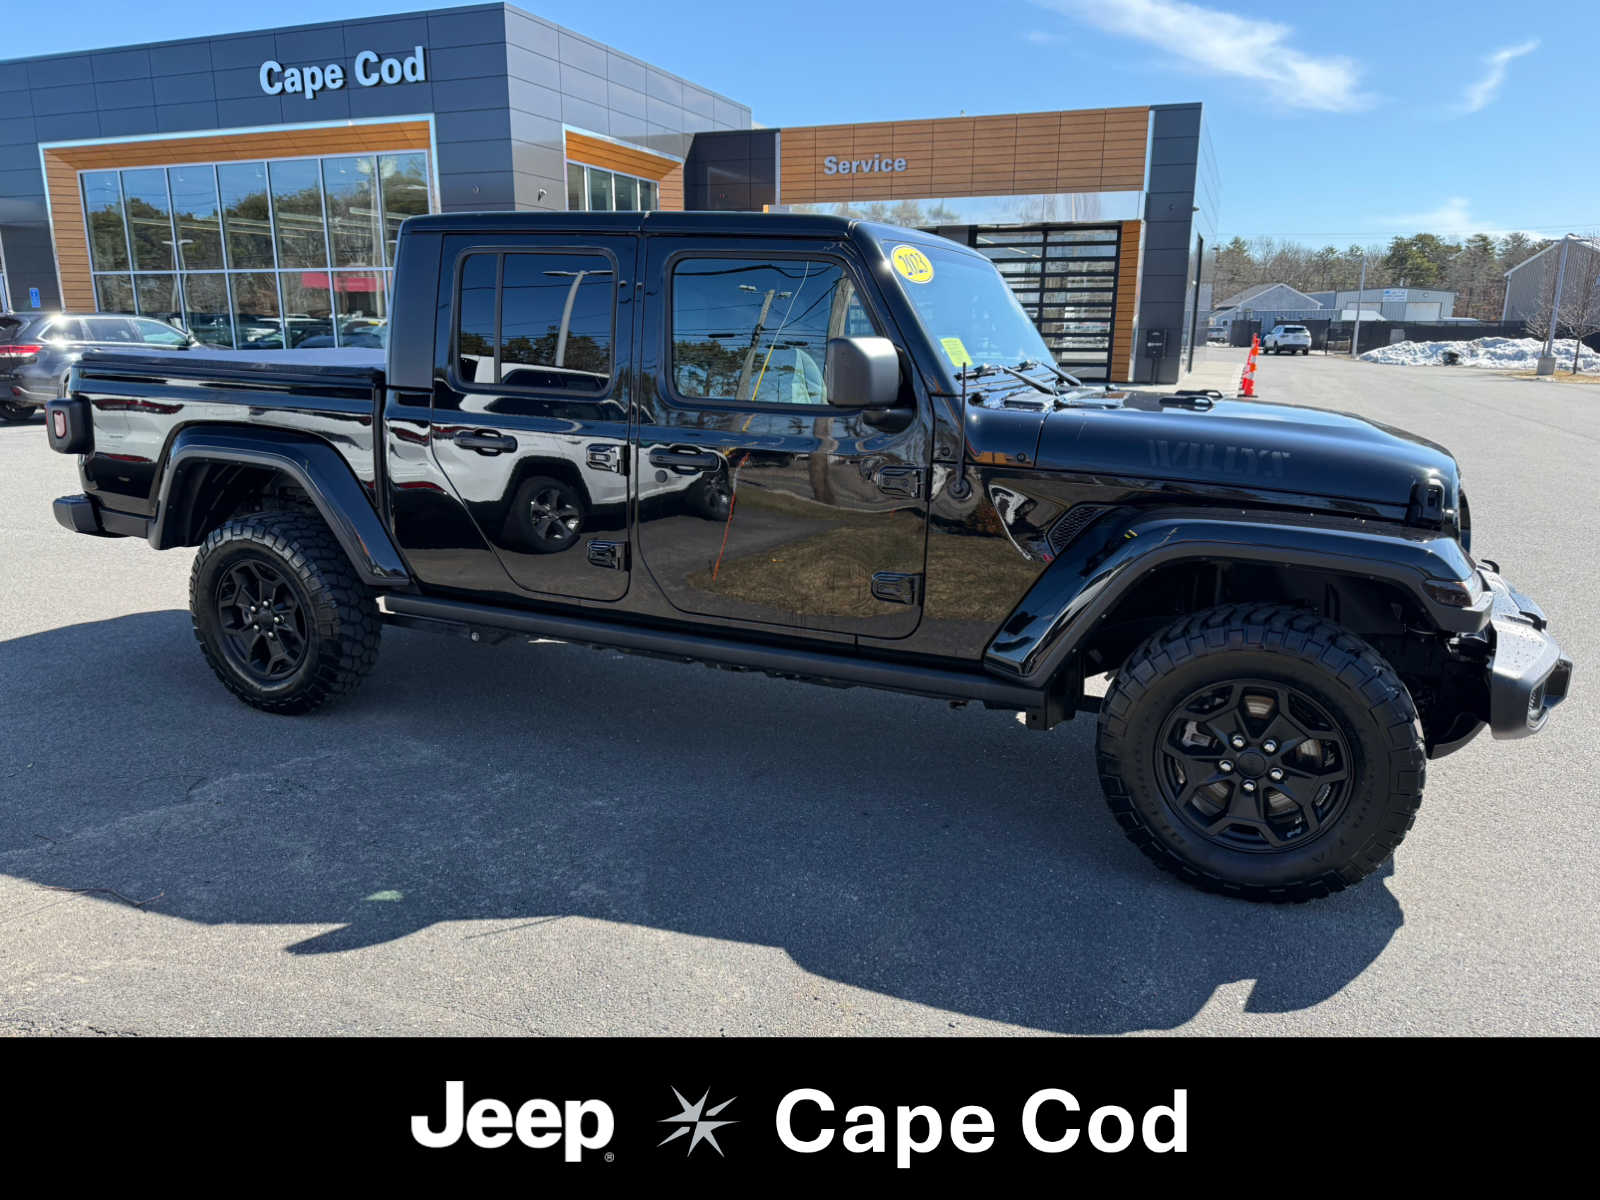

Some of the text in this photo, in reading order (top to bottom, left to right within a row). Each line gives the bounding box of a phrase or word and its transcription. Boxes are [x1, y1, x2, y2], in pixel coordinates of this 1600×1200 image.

[260, 46, 425, 99] Cape Cod
[824, 154, 907, 175] Service
[898, 252, 929, 276] 2023
